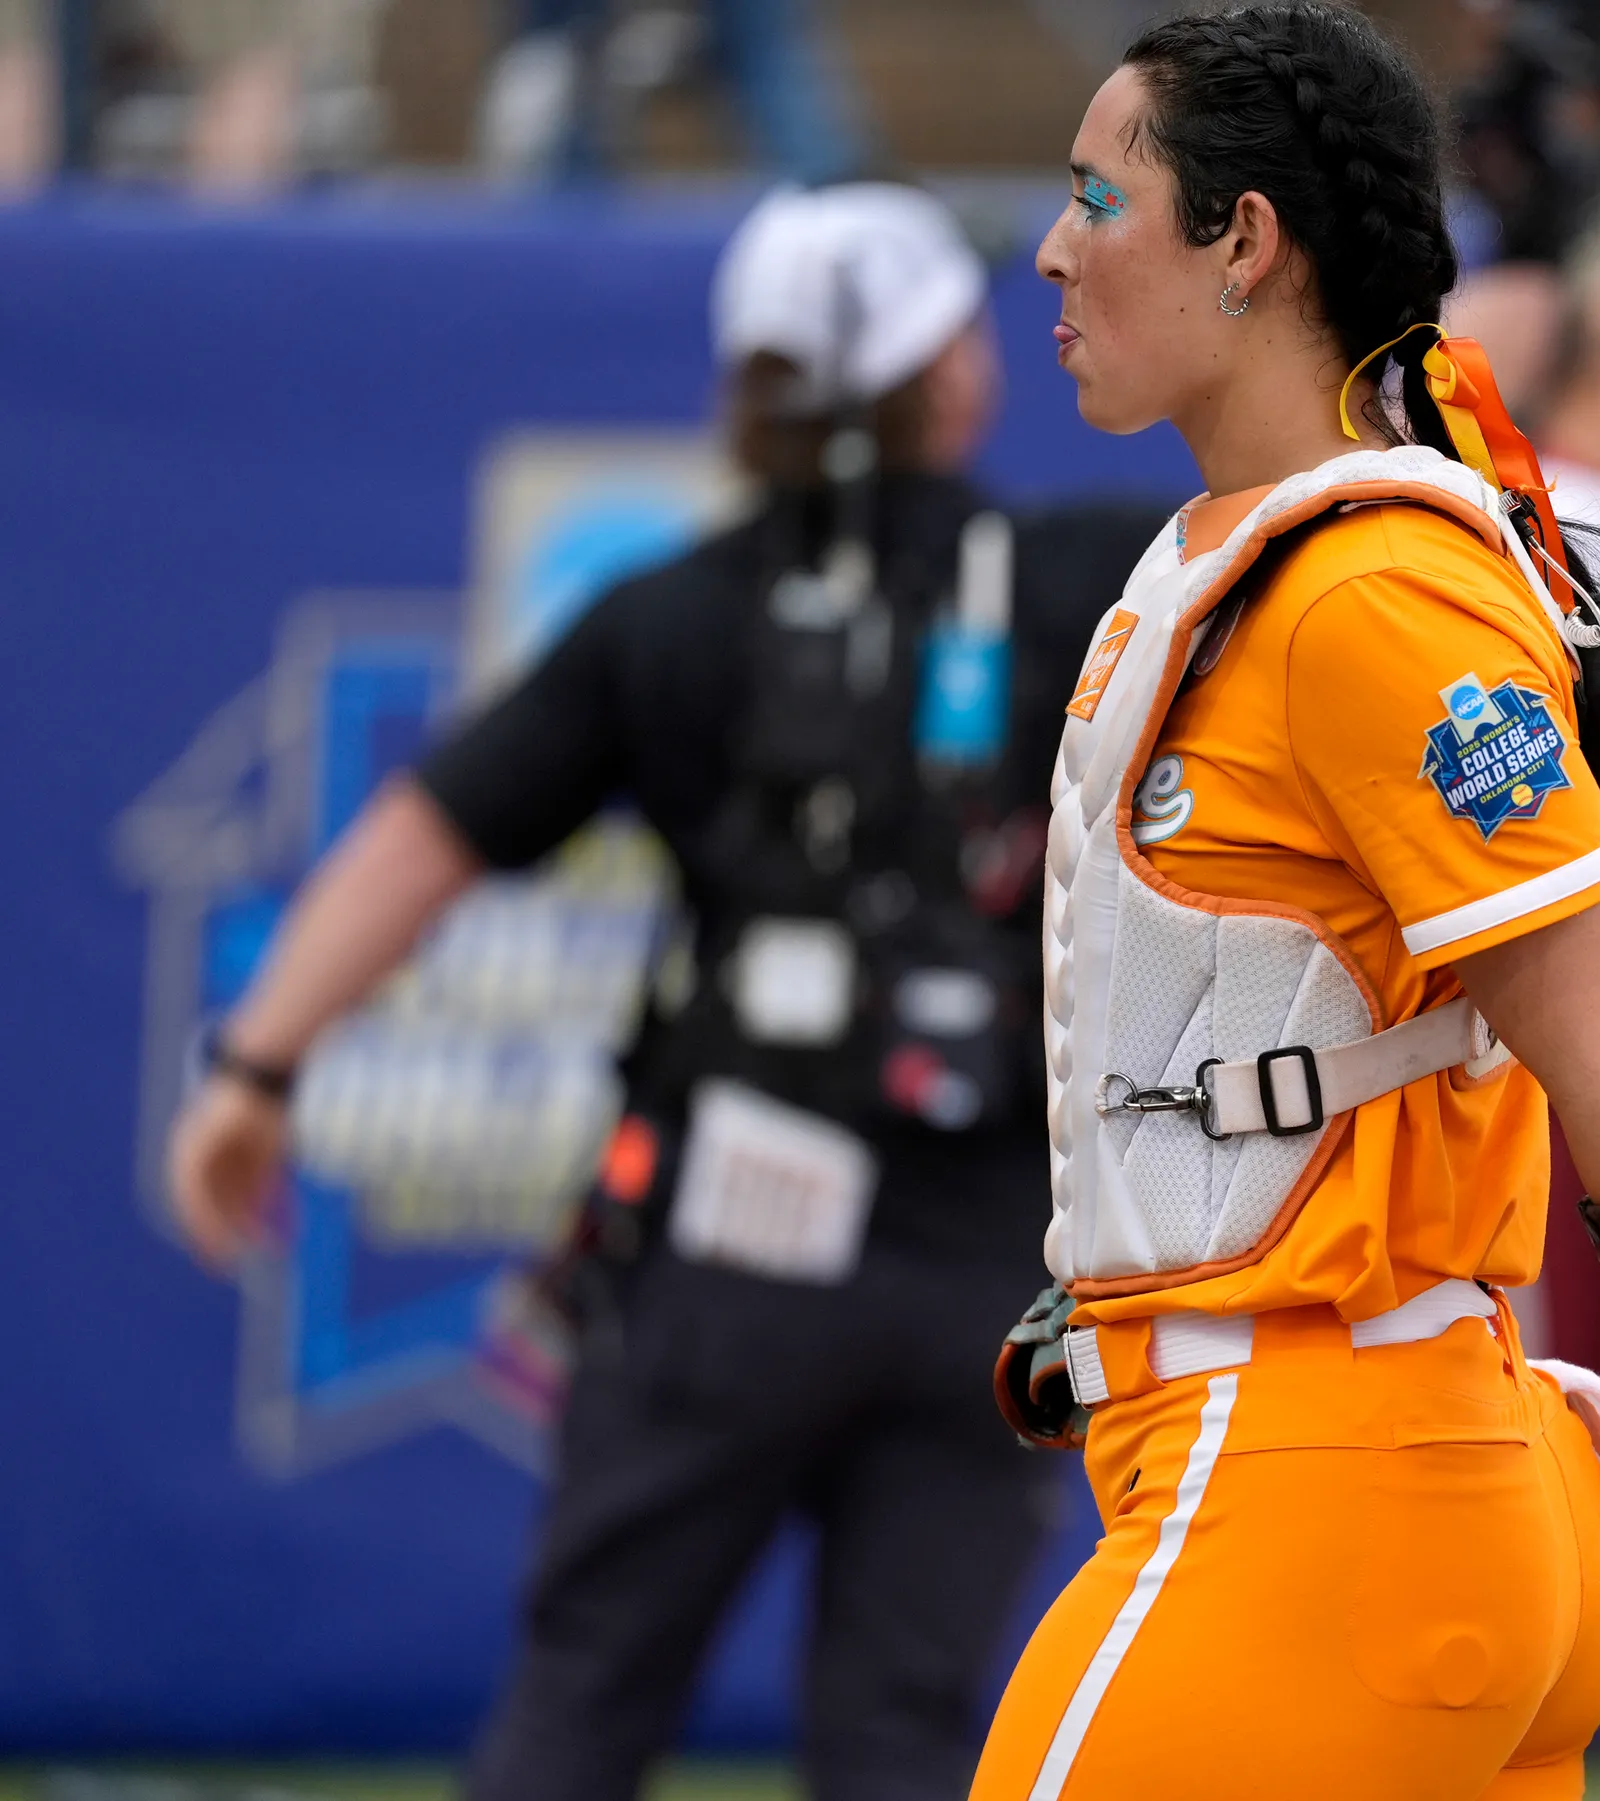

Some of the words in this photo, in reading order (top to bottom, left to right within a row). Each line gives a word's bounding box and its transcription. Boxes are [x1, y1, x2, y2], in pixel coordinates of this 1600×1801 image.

[1456, 692, 1485, 717] NCAA
[1456, 741, 1481, 759] 2025
[1481, 715, 1521, 743] WOMEN'S
[1461, 722, 1530, 777] COLLEGE
[1447, 762, 1506, 809] WORLD
[1508, 728, 1558, 774] SERIES
[1480, 771, 1527, 804] OKLAHOMA
[1527, 760, 1546, 776] CITY
